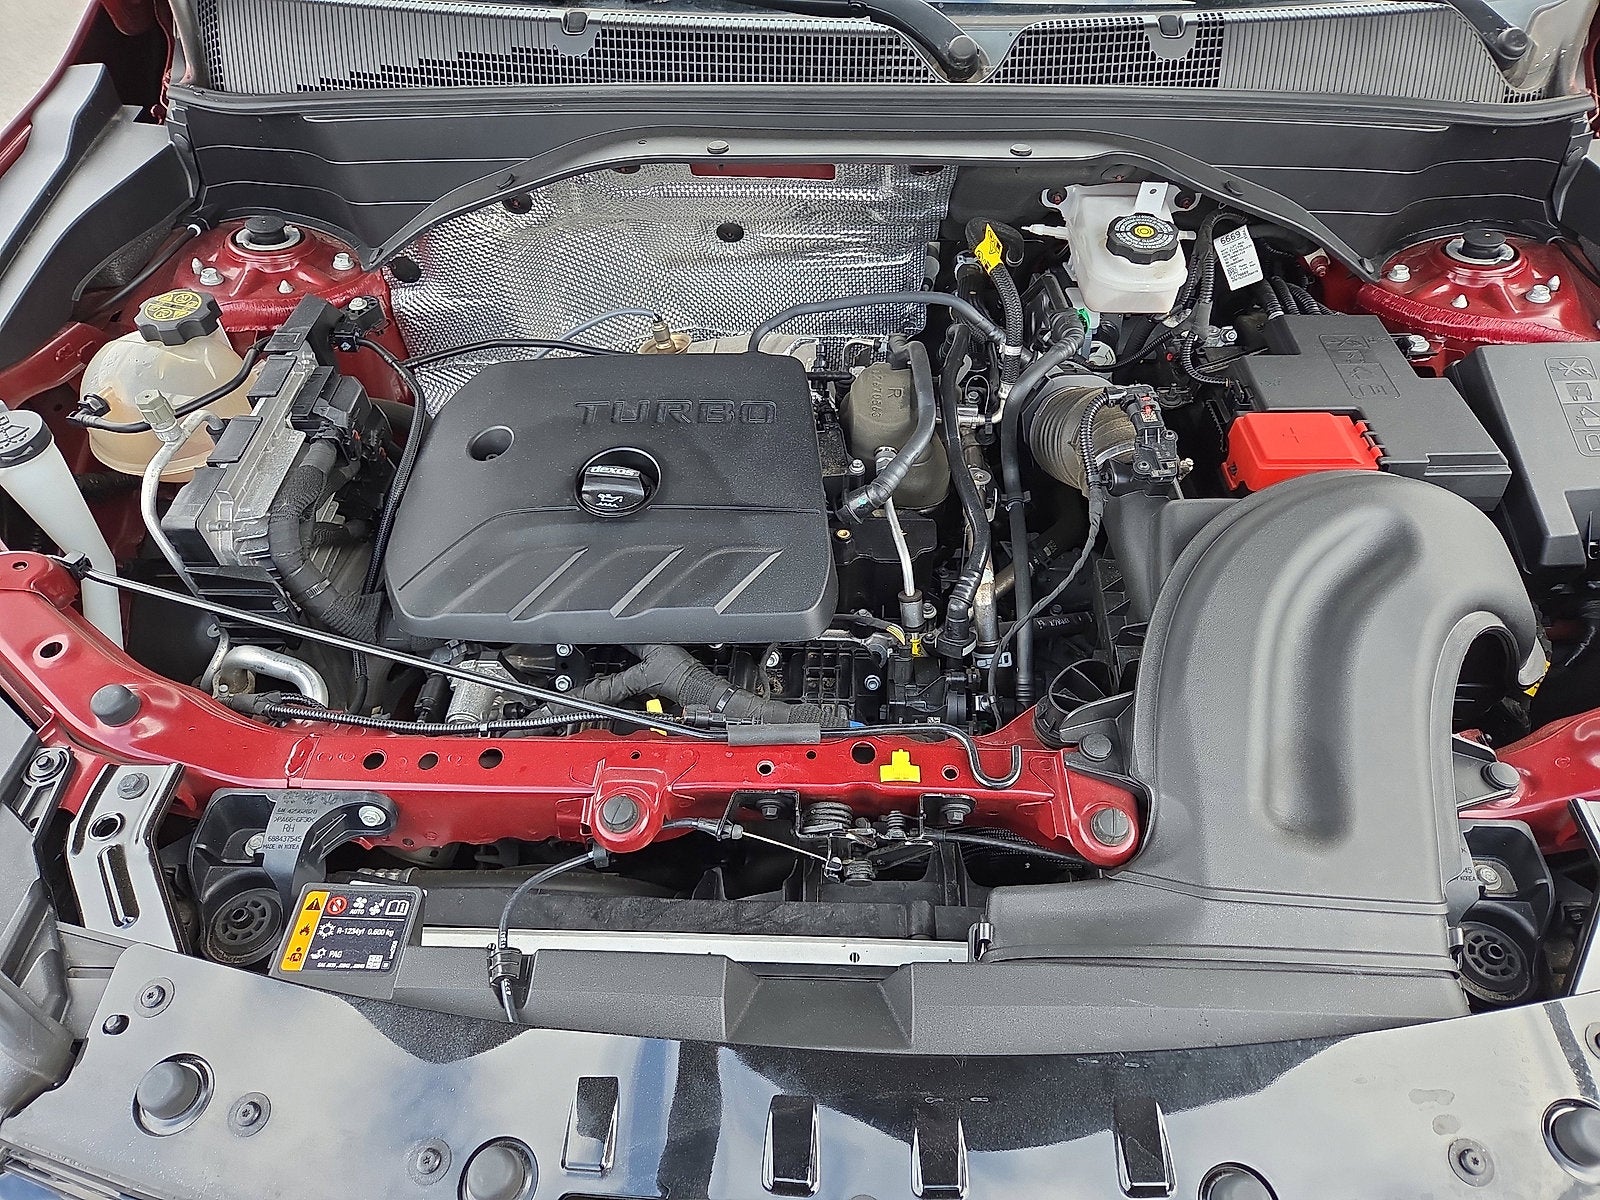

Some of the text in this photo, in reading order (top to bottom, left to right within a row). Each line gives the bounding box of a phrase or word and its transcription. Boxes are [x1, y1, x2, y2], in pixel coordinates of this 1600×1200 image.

[1220, 231, 1241, 244] 6669
[888, 387, 904, 398] R
[575, 399, 778, 424] TURBO
[590, 465, 634, 476] dexos
[282, 824, 296, 832] RH
[386, 928, 394, 937] kg
[328, 950, 343, 959] PAG
